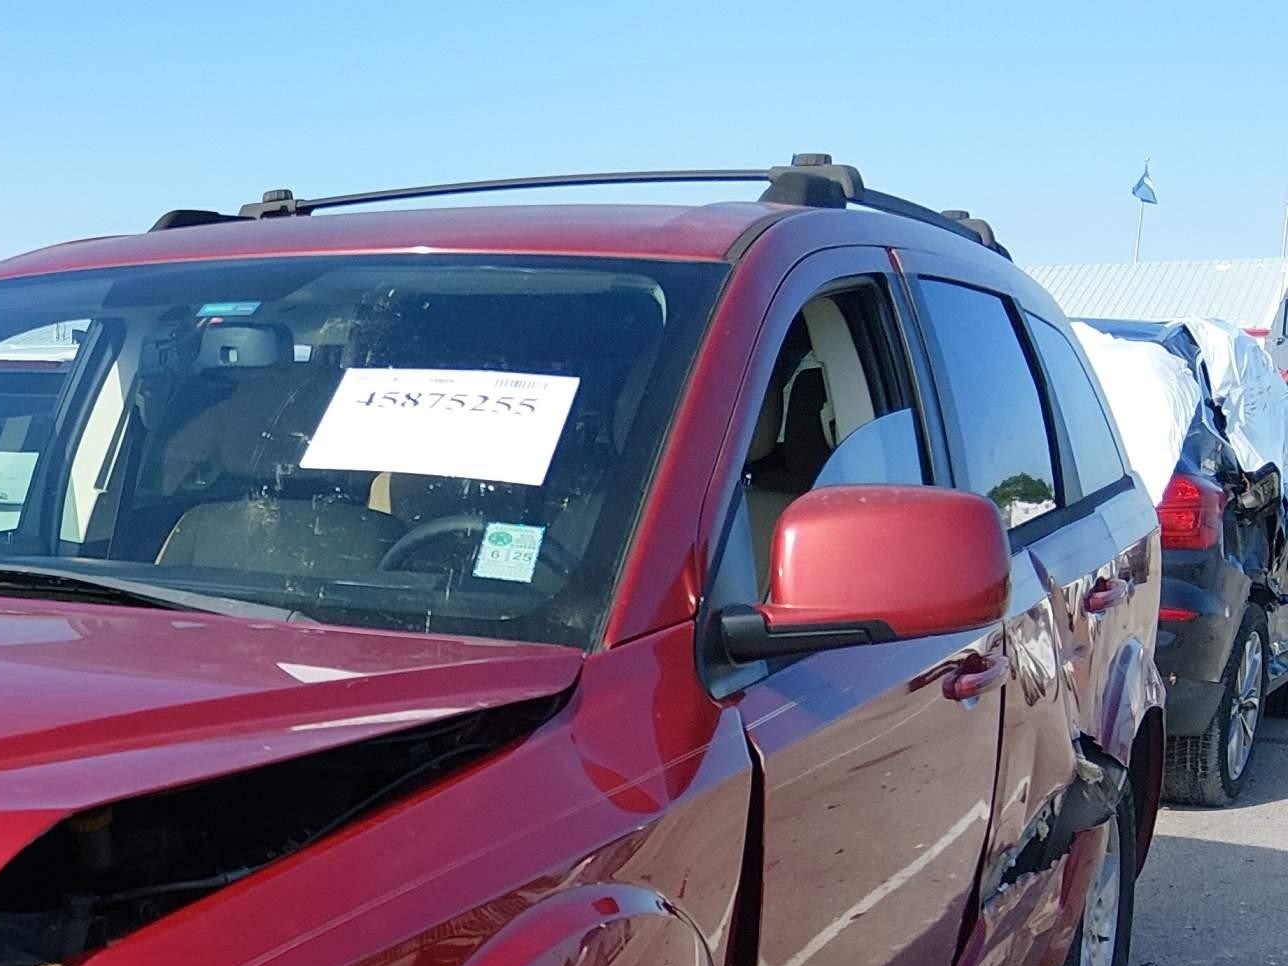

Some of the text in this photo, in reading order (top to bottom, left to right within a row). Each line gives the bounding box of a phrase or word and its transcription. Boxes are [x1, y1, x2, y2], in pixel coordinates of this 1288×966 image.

[356, 391, 539, 416] 45875255
[490, 550, 532, 561] 6 25
